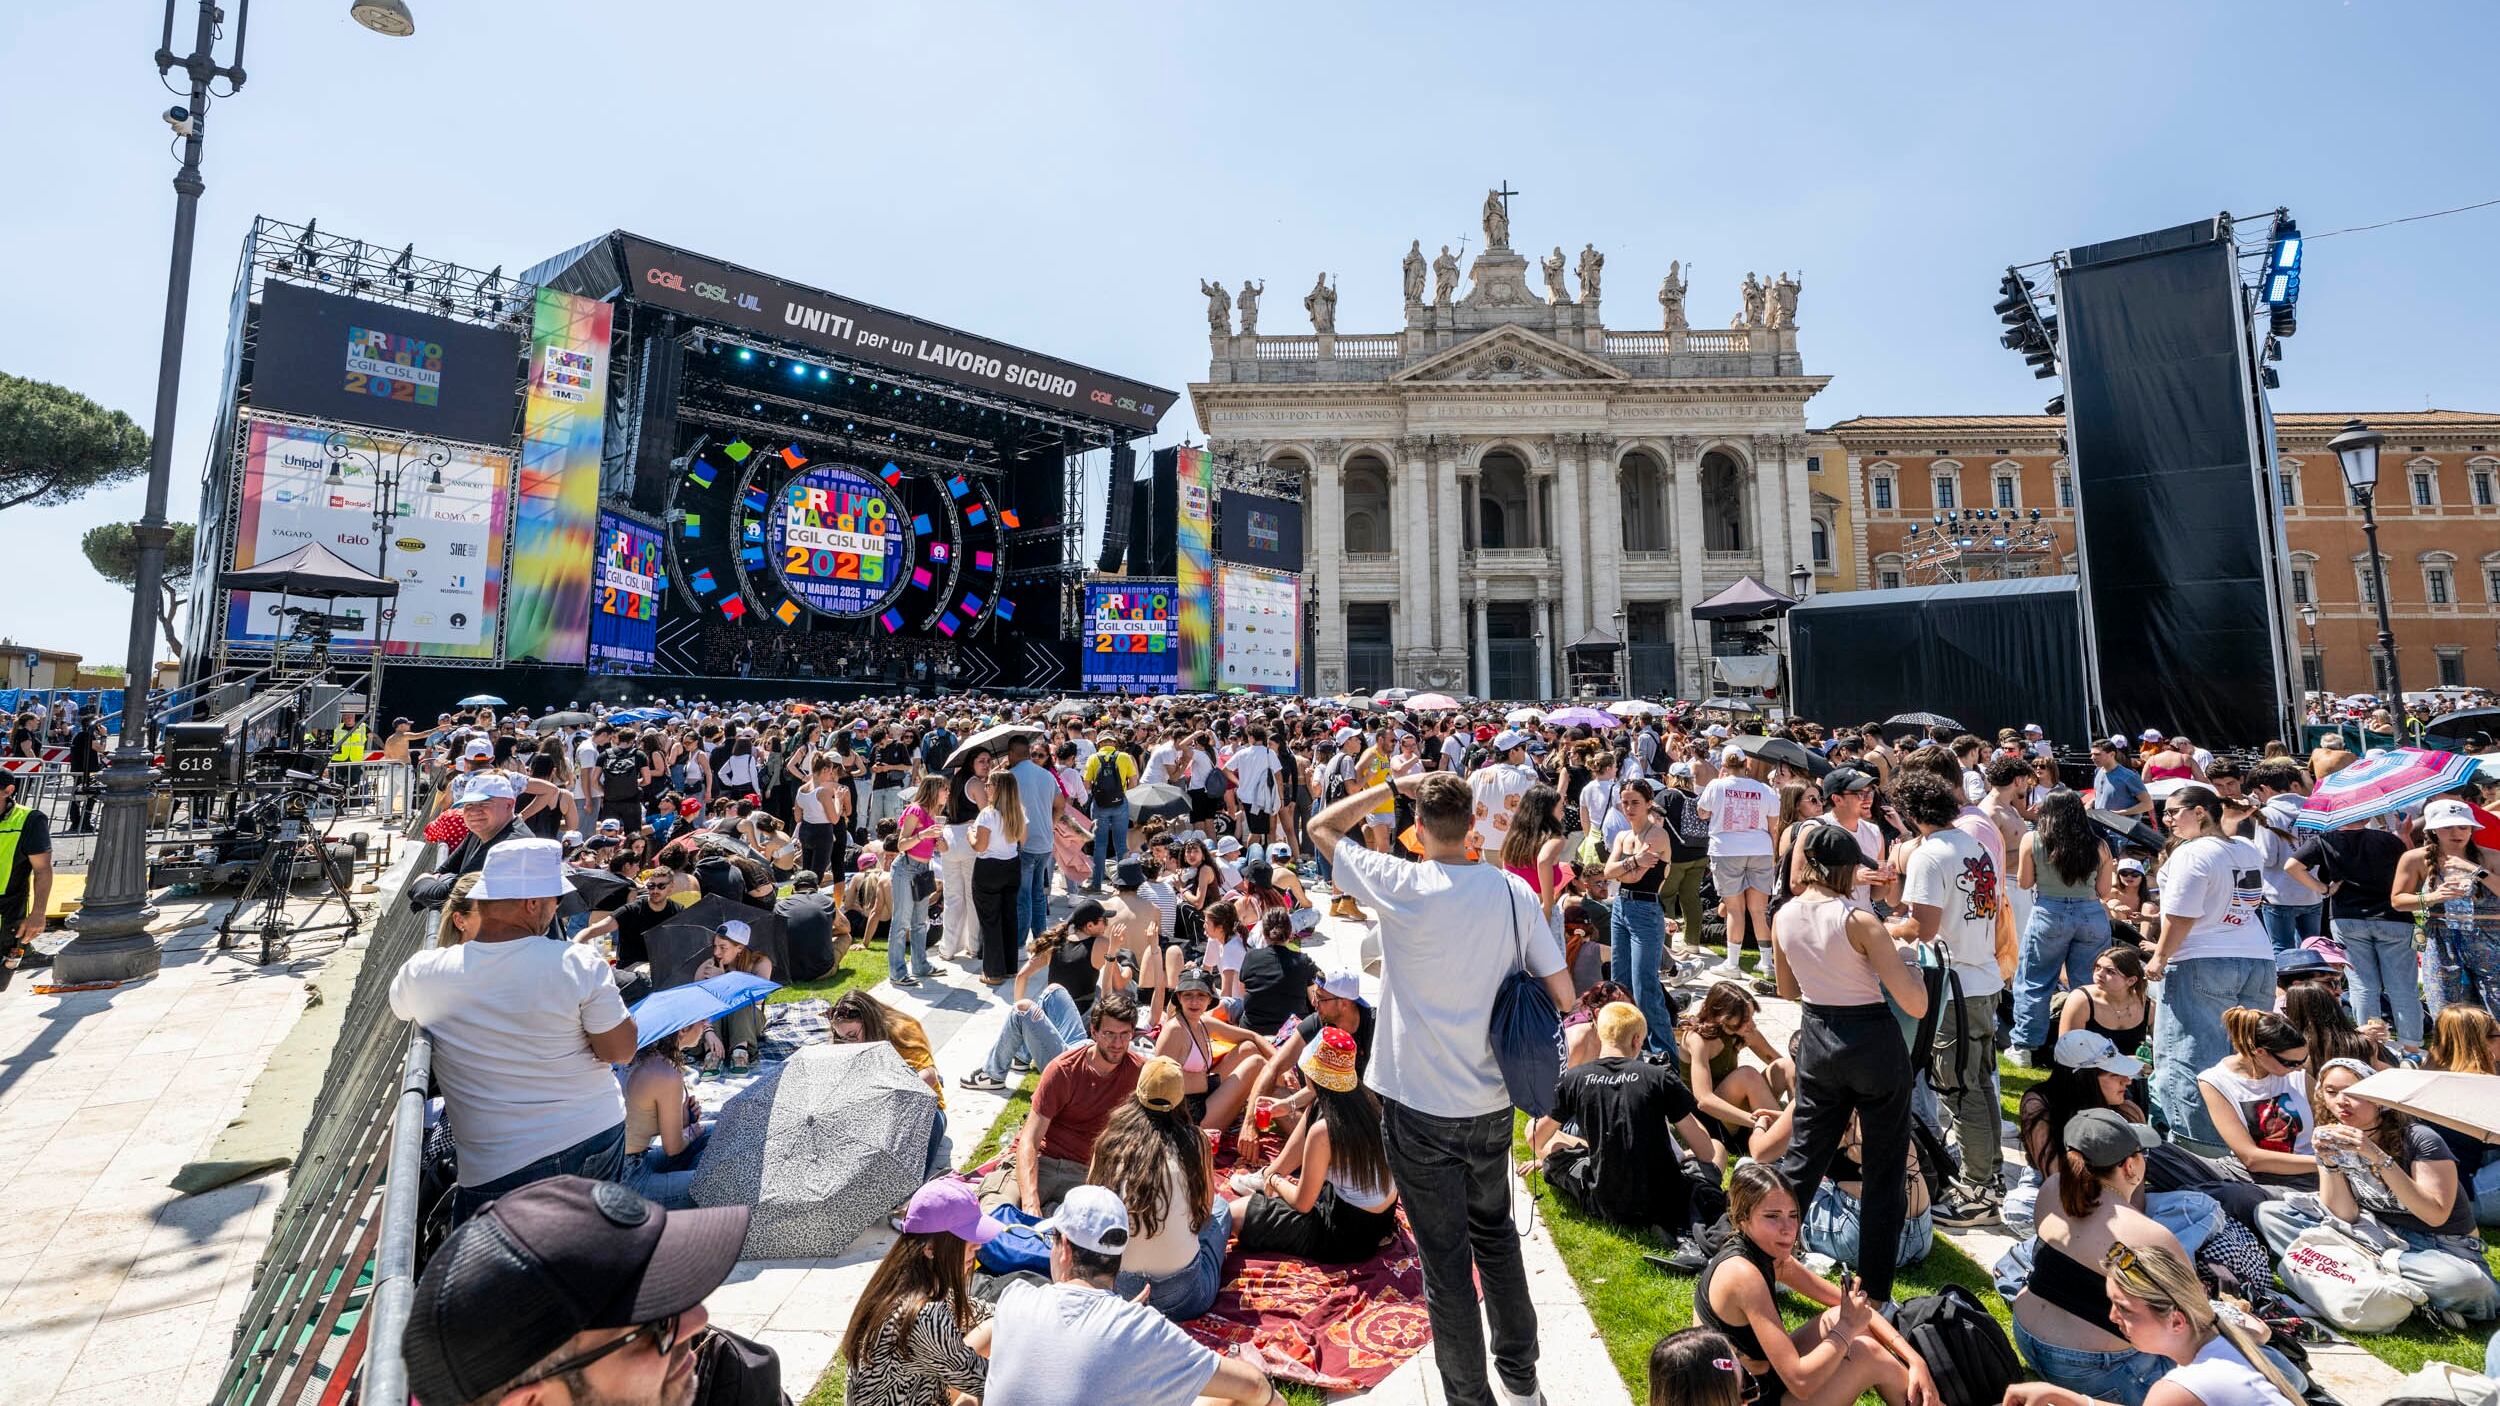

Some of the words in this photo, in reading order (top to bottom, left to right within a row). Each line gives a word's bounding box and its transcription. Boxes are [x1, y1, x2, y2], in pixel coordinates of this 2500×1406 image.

[349, 325, 443, 359] PRIMO
[647, 268, 687, 292] CGIL
[694, 281, 730, 304] CISL
[737, 292, 762, 312] UIL
[784, 302, 854, 340] UNITI
[856, 330, 888, 351] per
[892, 340, 912, 357] un
[917, 340, 1002, 379] LAVORO
[1005, 364, 1077, 398] SICURO
[347, 358, 380, 373] CGIL
[384, 365, 413, 379] CISL
[418, 370, 439, 384] UIL
[344, 372, 439, 406] 2025
[1326, 411, 1352, 420] MAX
[1357, 410, 1391, 419] ANNO
[284, 454, 323, 470] Unipol
[788, 485, 887, 519] PRIMO
[434, 511, 467, 521] ROMA
[787, 505, 886, 537] MAGGIO
[337, 533, 370, 546] italo
[608, 528, 655, 562] PRIMO
[788, 529, 822, 545] CGIL
[827, 533, 857, 549] CISL
[861, 538, 883, 551] UIL
[450, 542, 468, 556] SIAE
[785, 546, 884, 582] 2025
[606, 570, 624, 585] CGIL
[625, 575, 639, 590] CISL
[641, 579, 652, 592] UIL
[807, 583, 838, 595] MAGGIO
[840, 586, 861, 598] 2025
[603, 586, 652, 621] 2025
[824, 597, 860, 612] MAGGIO
[1096, 593, 1167, 610] PRIMO
[1097, 622, 1121, 631] CGIL
[1124, 622, 1146, 631] CISL
[1149, 623, 1166, 632] UIL
[1096, 633, 1167, 653] 2025
[1093, 674, 1117, 683] MAGGIO
[1118, 674, 1135, 683] 2025
[1139, 674, 1160, 683] PRIMO
[178, 757, 213, 771] 618
[1726, 790, 1761, 800] SEVILLA
[1584, 1072, 1639, 1086] THAILAND
[2315, 1263, 2356, 1285] DESIGN
